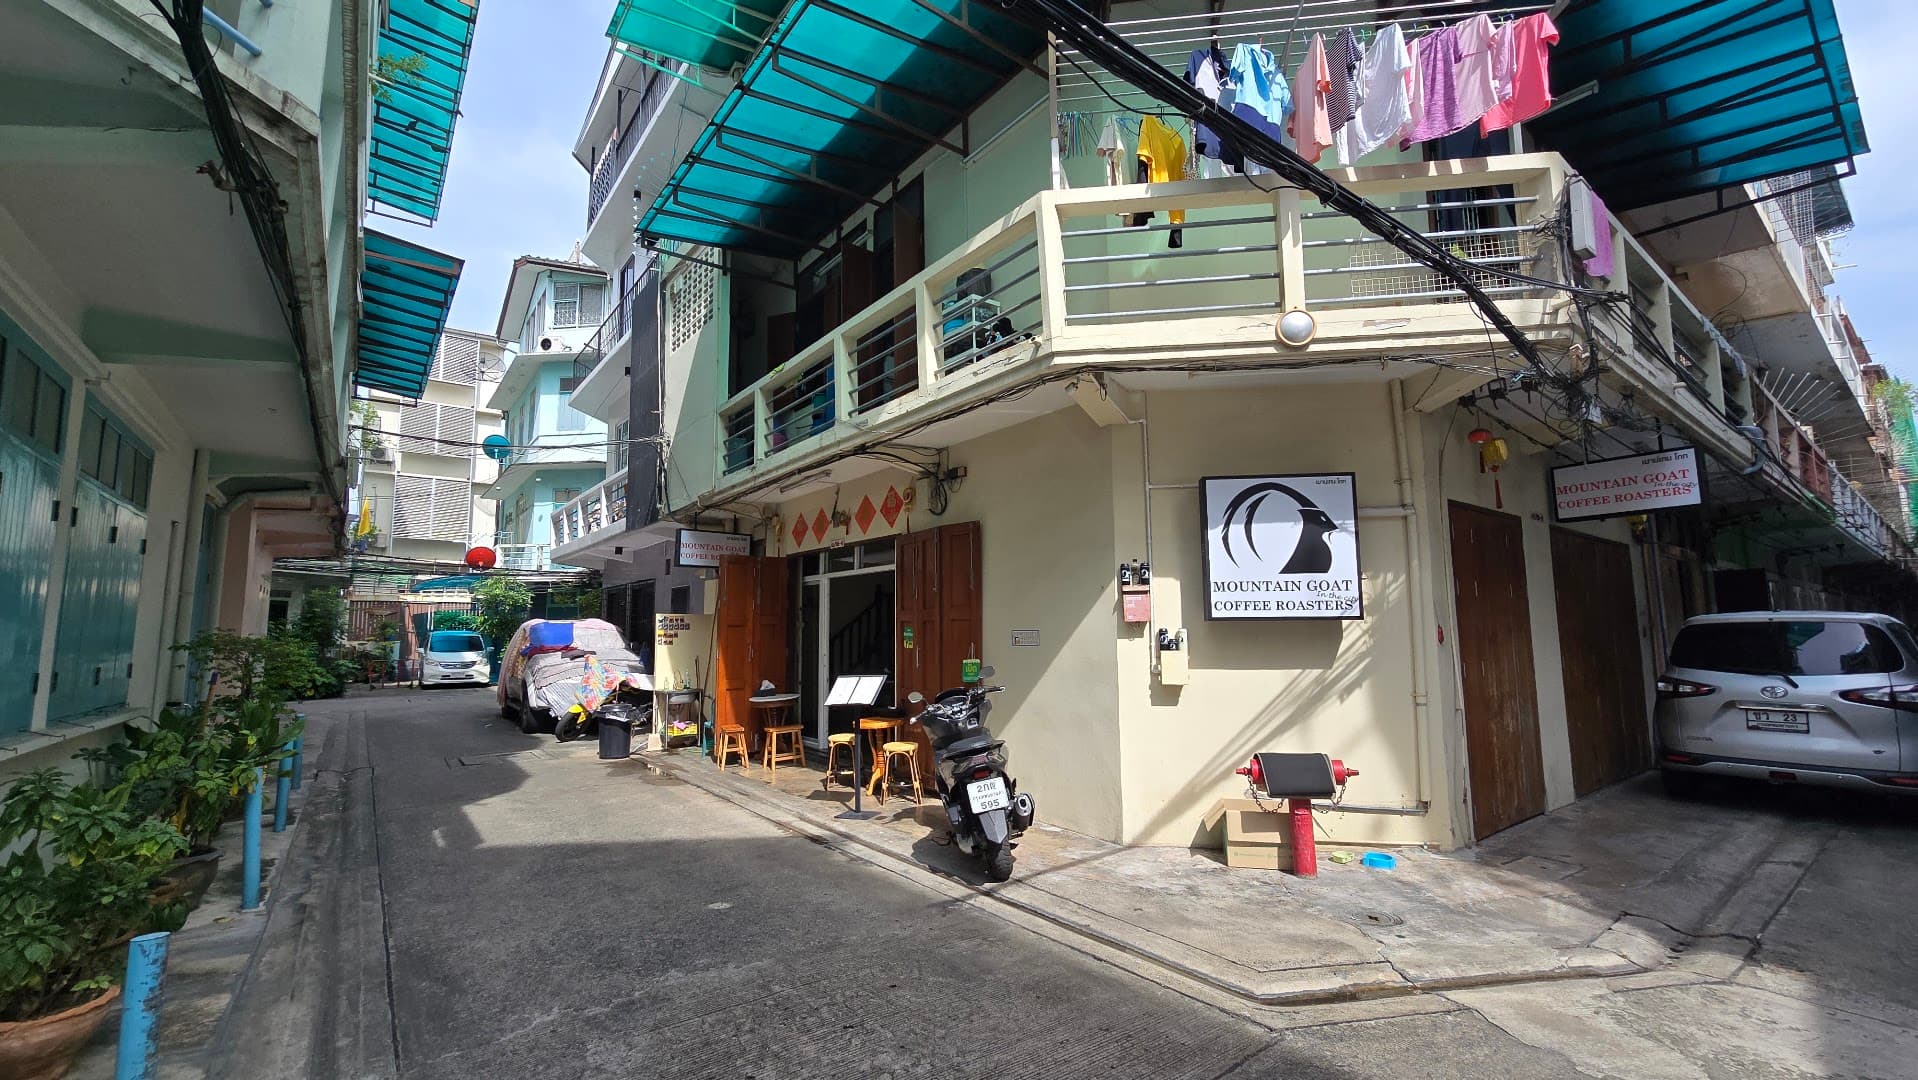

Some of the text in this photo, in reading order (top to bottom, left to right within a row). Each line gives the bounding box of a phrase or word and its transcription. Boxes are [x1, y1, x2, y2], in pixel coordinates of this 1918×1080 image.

[1556, 469, 1690, 495] MOUNTAIN GOAT
[1558, 486, 1692, 509] COFFEE ROASTERS
[1213, 579, 1353, 593] MOUNTAIN GOAT
[1214, 600, 1354, 611] COFFEE ROASTERS
[1783, 713, 1797, 721] 23
[980, 799, 1000, 810] 595
